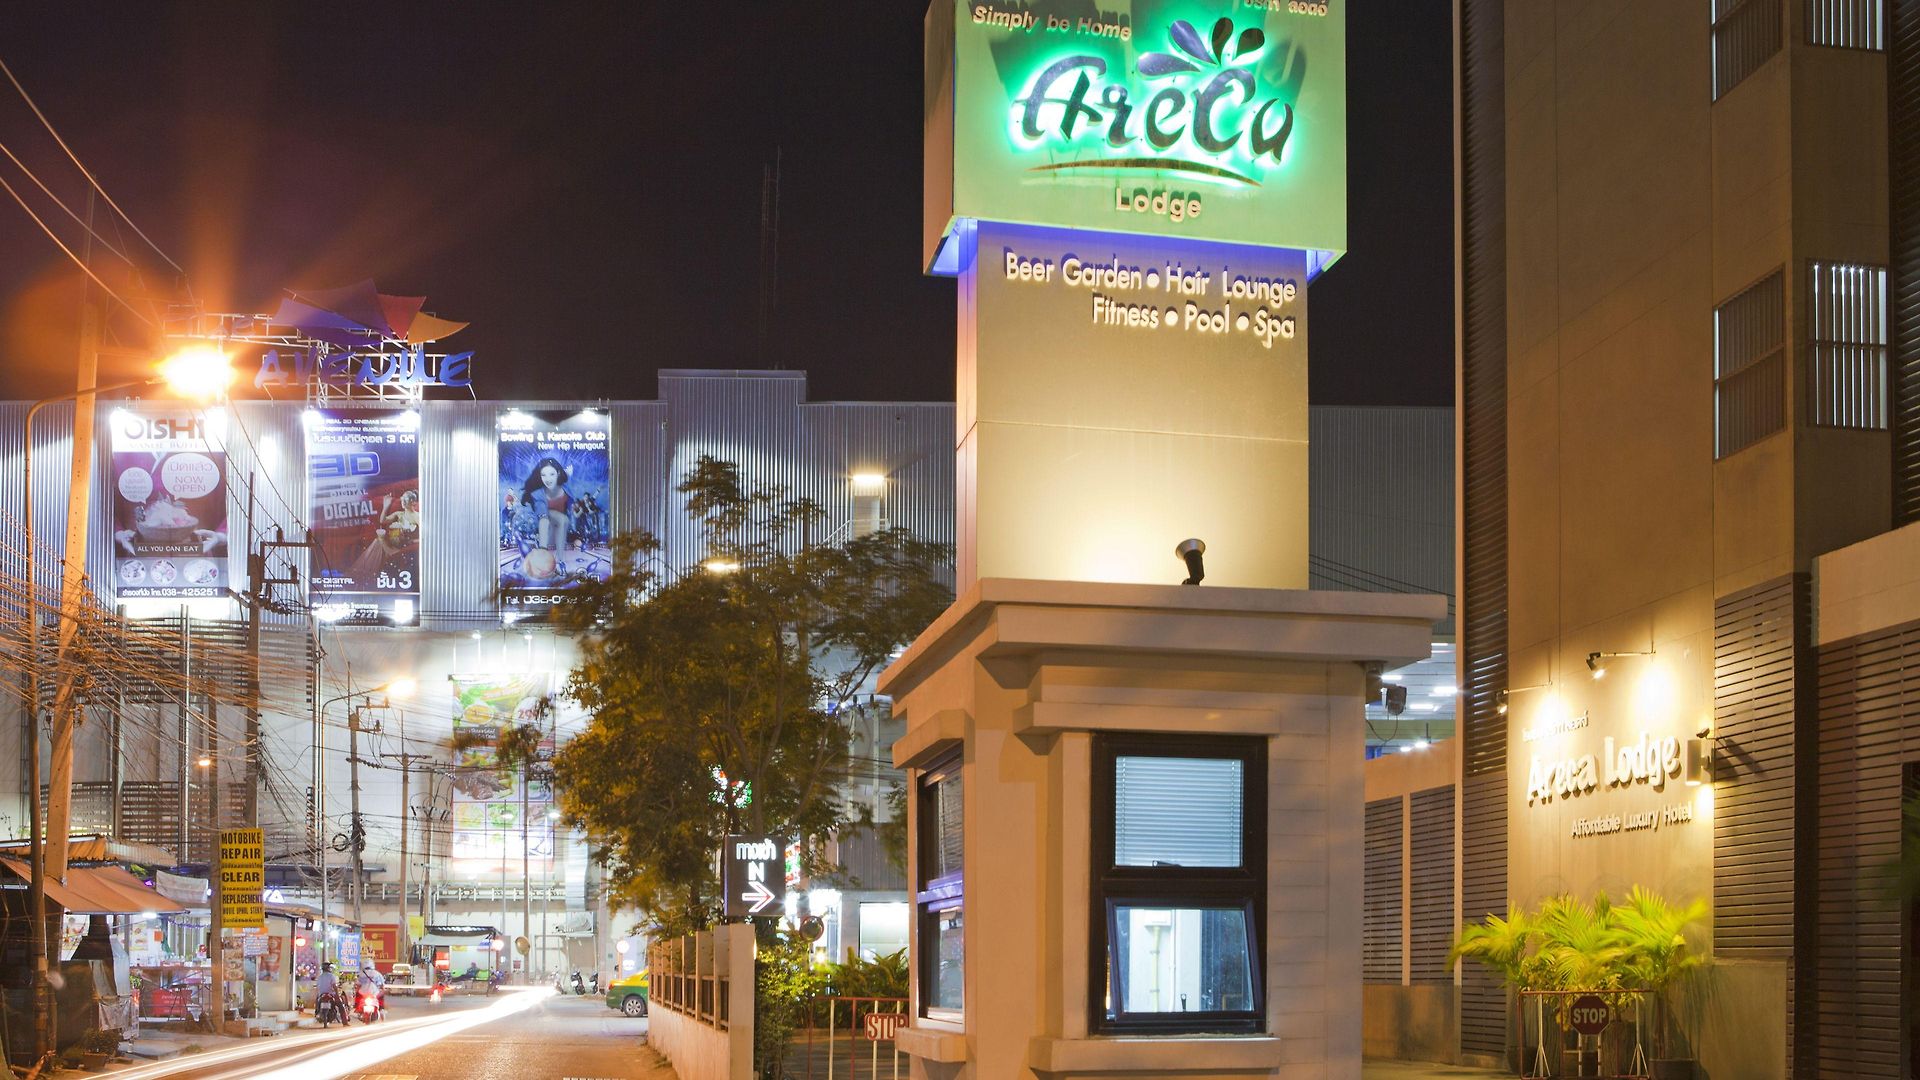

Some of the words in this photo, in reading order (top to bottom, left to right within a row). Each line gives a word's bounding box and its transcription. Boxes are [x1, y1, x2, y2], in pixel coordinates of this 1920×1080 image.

[973, 5, 1039, 33] Simply
[1046, 14, 1070, 32] be
[1077, 17, 1132, 41] Home
[1115, 187, 1201, 222] Lodge
[1006, 251, 1055, 282] Beer
[1062, 255, 1142, 290] Garden
[1165, 262, 1210, 296] Hair
[1222, 268, 1296, 309] Lounge
[1093, 296, 1159, 329] Fitness
[1184, 302, 1230, 334] Pool
[1253, 309, 1295, 349] Spa
[254, 349, 476, 389] AVENUE
[124, 418, 206, 440] OISHI
[386, 434, 396, 443] 3
[500, 432, 534, 443] Bowling
[537, 432, 545, 442] &
[547, 431, 583, 442] Karaoke
[585, 431, 606, 441] Club
[537, 442, 555, 450] New
[557, 441, 571, 451] Hip
[307, 451, 380, 478] 3D
[173, 485, 206, 493] OPEN
[175, 476, 203, 484] NOW
[323, 500, 378, 520] DIGITAL
[376, 571, 396, 589] ชั้น
[398, 570, 412, 589] 3
[1526, 753, 1599, 802] Areca
[1604, 732, 1680, 788] Lodge
[1571, 813, 1622, 839] Affordable
[1623, 809, 1661, 832] Luxury
[1663, 801, 1692, 824] Hotel
[221, 832, 261, 845] MOTOBIKE
[221, 848, 261, 859] REPAIR
[222, 872, 260, 882] CLEAR
[222, 894, 263, 904] REPLACEMENT
[1573, 1007, 1607, 1025] STOP
